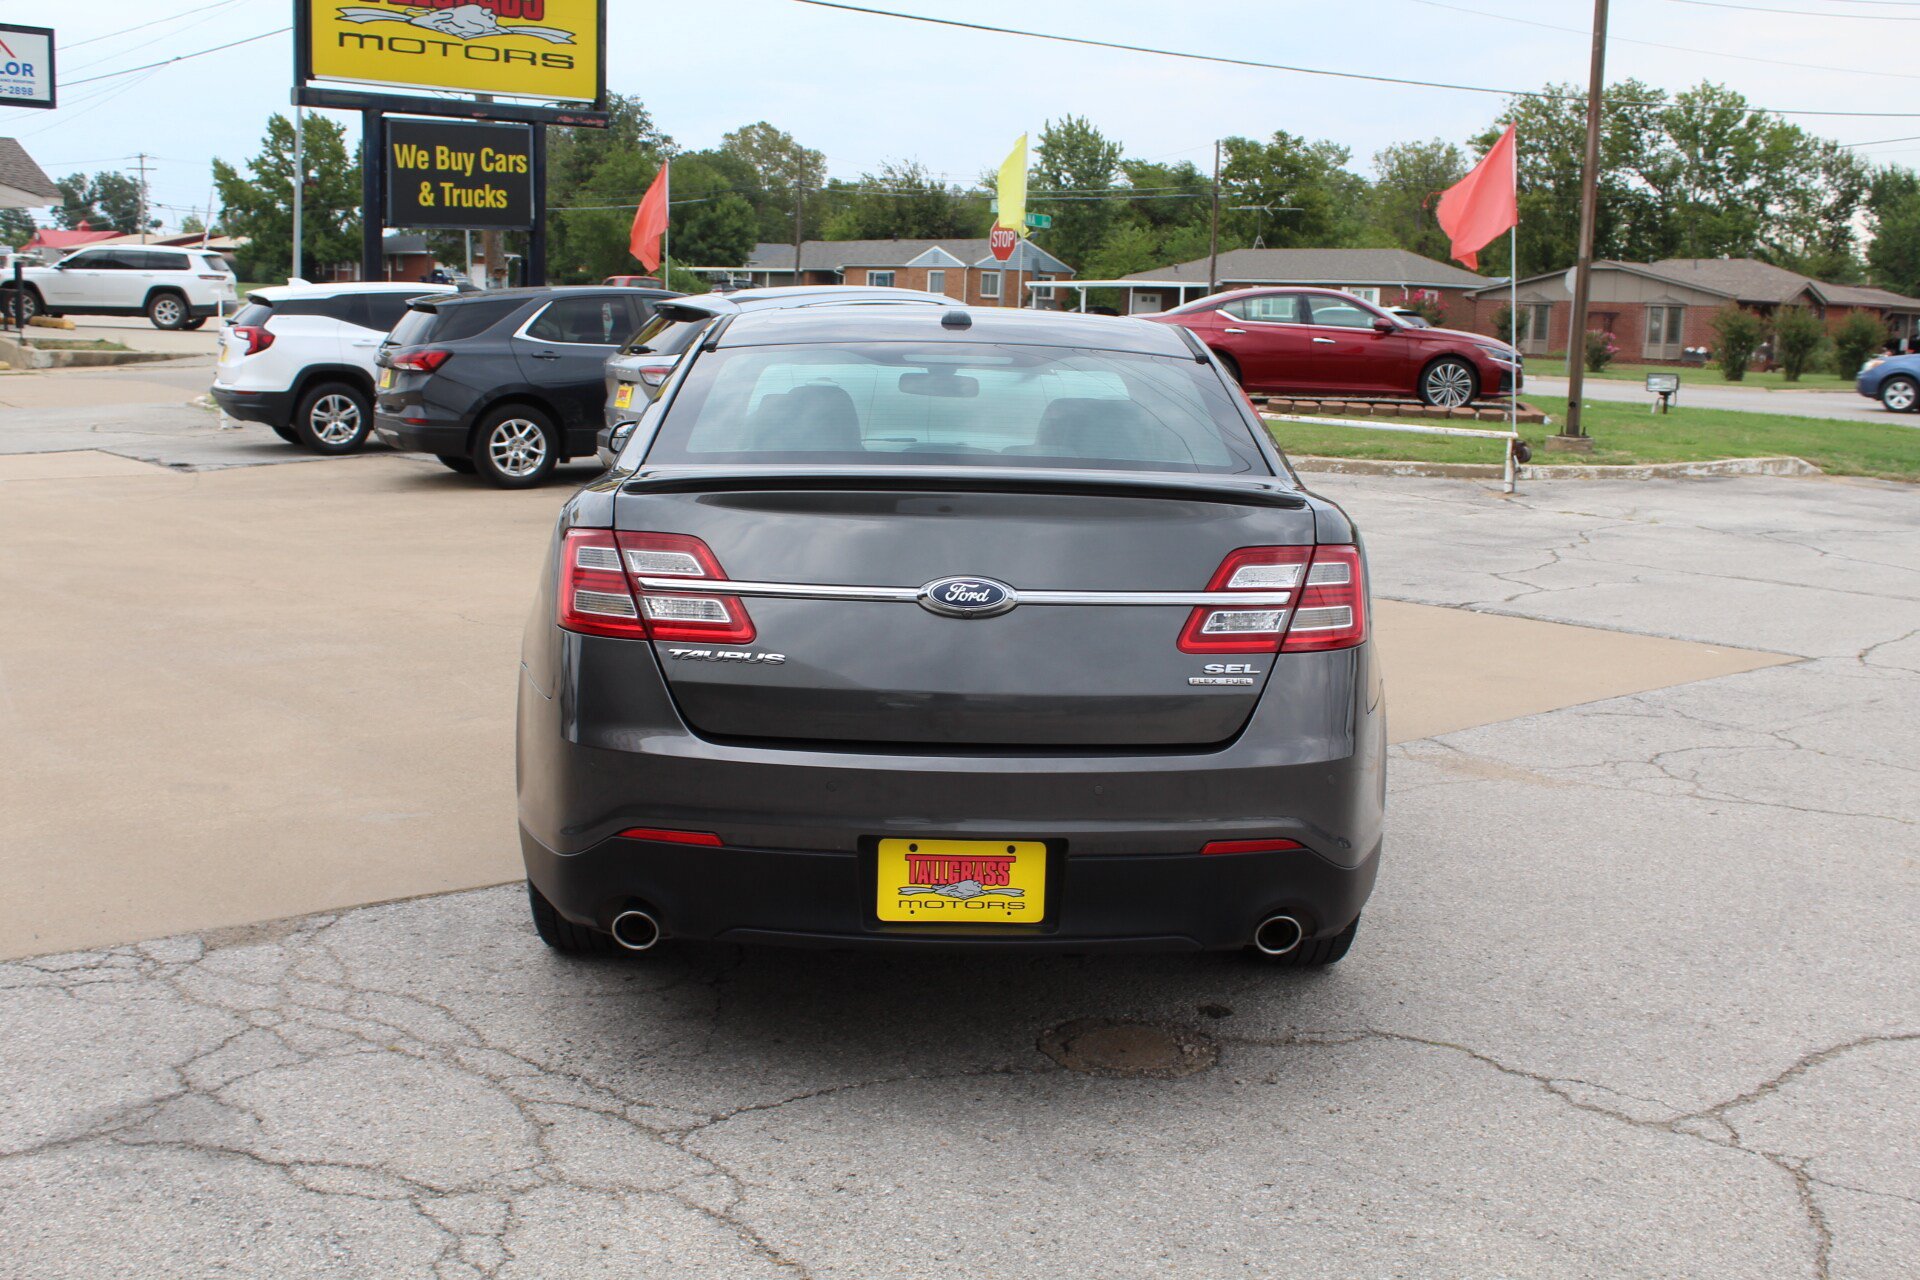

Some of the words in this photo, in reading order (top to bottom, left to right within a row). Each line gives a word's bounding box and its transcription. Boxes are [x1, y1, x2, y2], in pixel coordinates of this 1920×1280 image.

[338, 31, 575, 69] MOTORS
[393, 143, 430, 170] We
[435, 145, 475, 177] Buy
[480, 147, 528, 174] Cars
[418, 181, 435, 207] &
[440, 182, 508, 208] Trucks
[991, 230, 1015, 248] STOP
[944, 582, 991, 602] Ford
[668, 648, 787, 665] TAURUS
[1203, 663, 1261, 675] SEL
[905, 854, 1016, 887] TALLGRASS
[898, 899, 1026, 910] MOTORS
